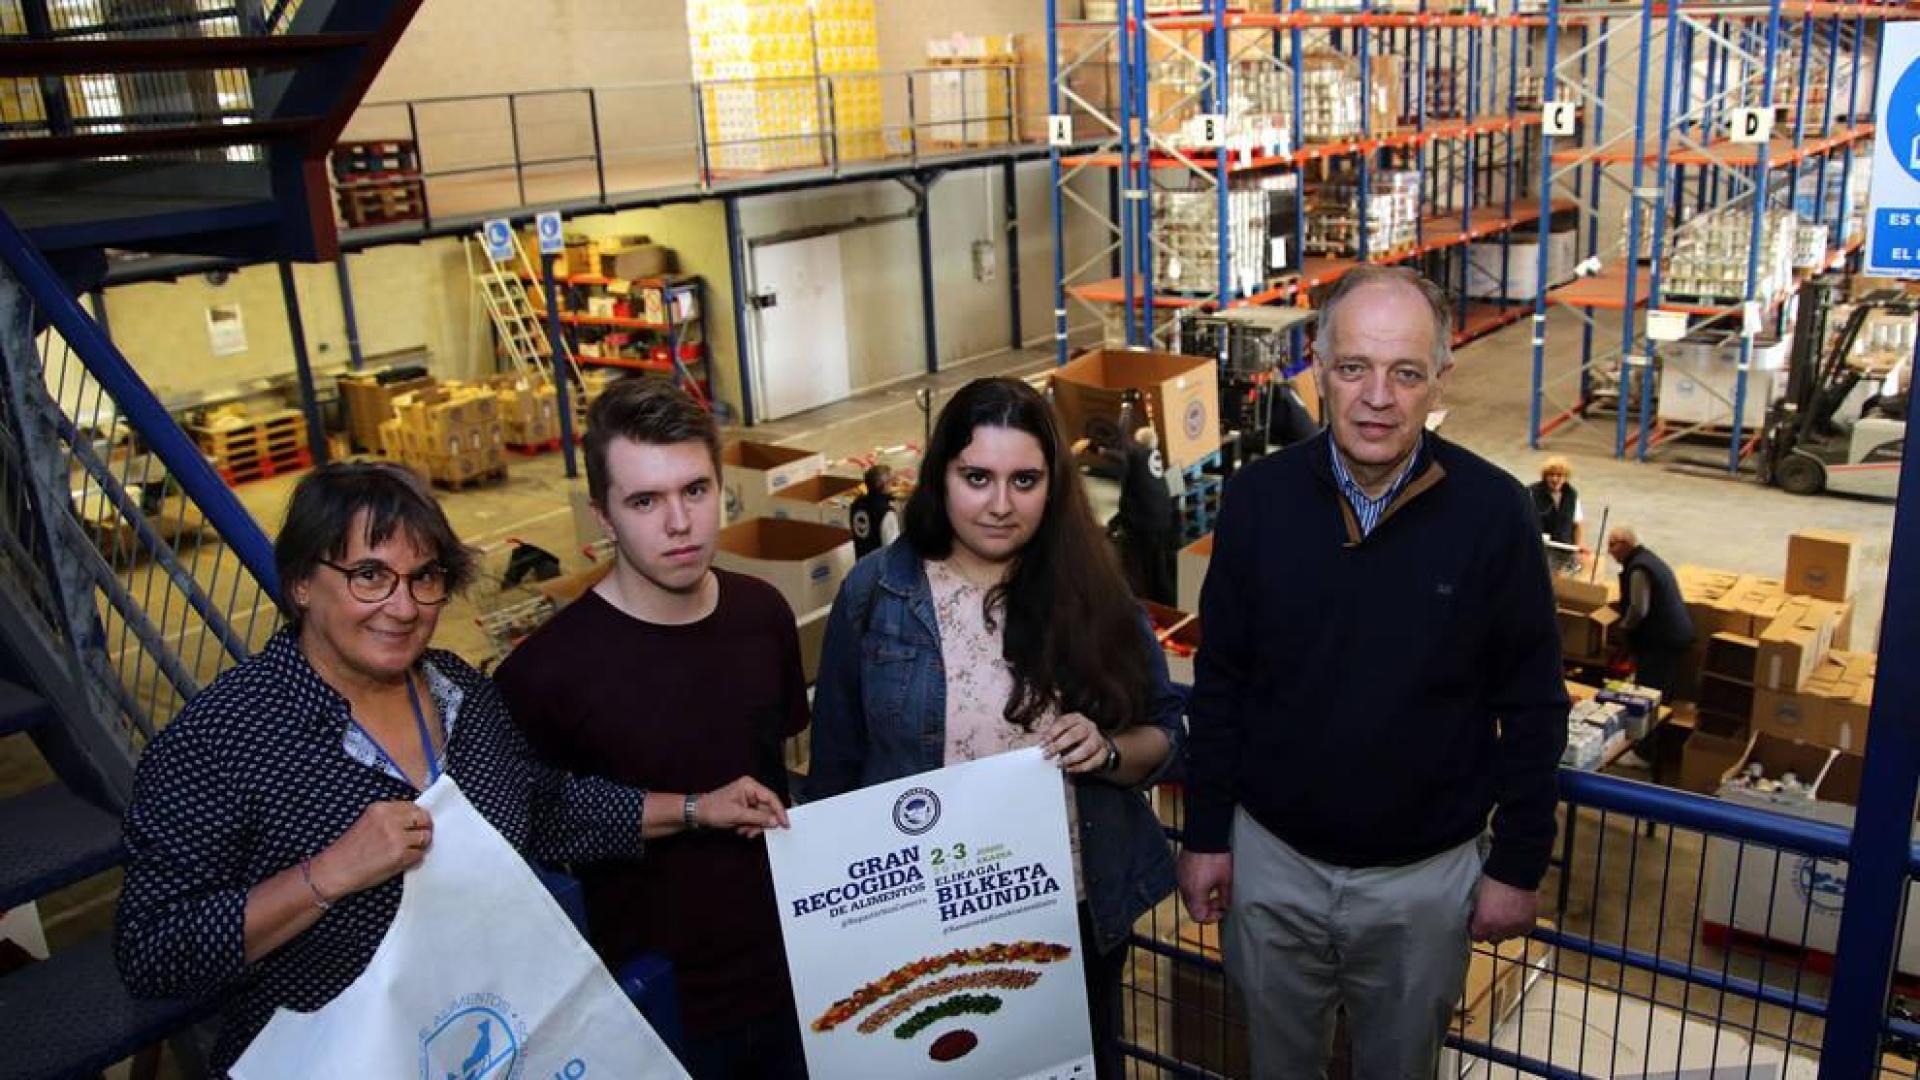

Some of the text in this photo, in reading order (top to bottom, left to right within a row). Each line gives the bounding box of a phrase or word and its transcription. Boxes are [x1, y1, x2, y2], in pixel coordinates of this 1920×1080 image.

[1057, 119, 1065, 139] A
[1206, 119, 1214, 141] B
[1554, 107, 1563, 129] C
[1745, 112, 1758, 136] D
[1888, 212, 1911, 226] ES
[1892, 247, 1913, 261] EL
[848, 845, 920, 879] GRAN
[934, 862, 1001, 887] ELIKAGAI
[936, 862, 1049, 904] BILKETA
[792, 864, 924, 918] RECOGIDA
[829, 904, 849, 918] DE
[850, 881, 926, 912] ALIMENTOS
[939, 877, 1060, 921] HAUNDIA
